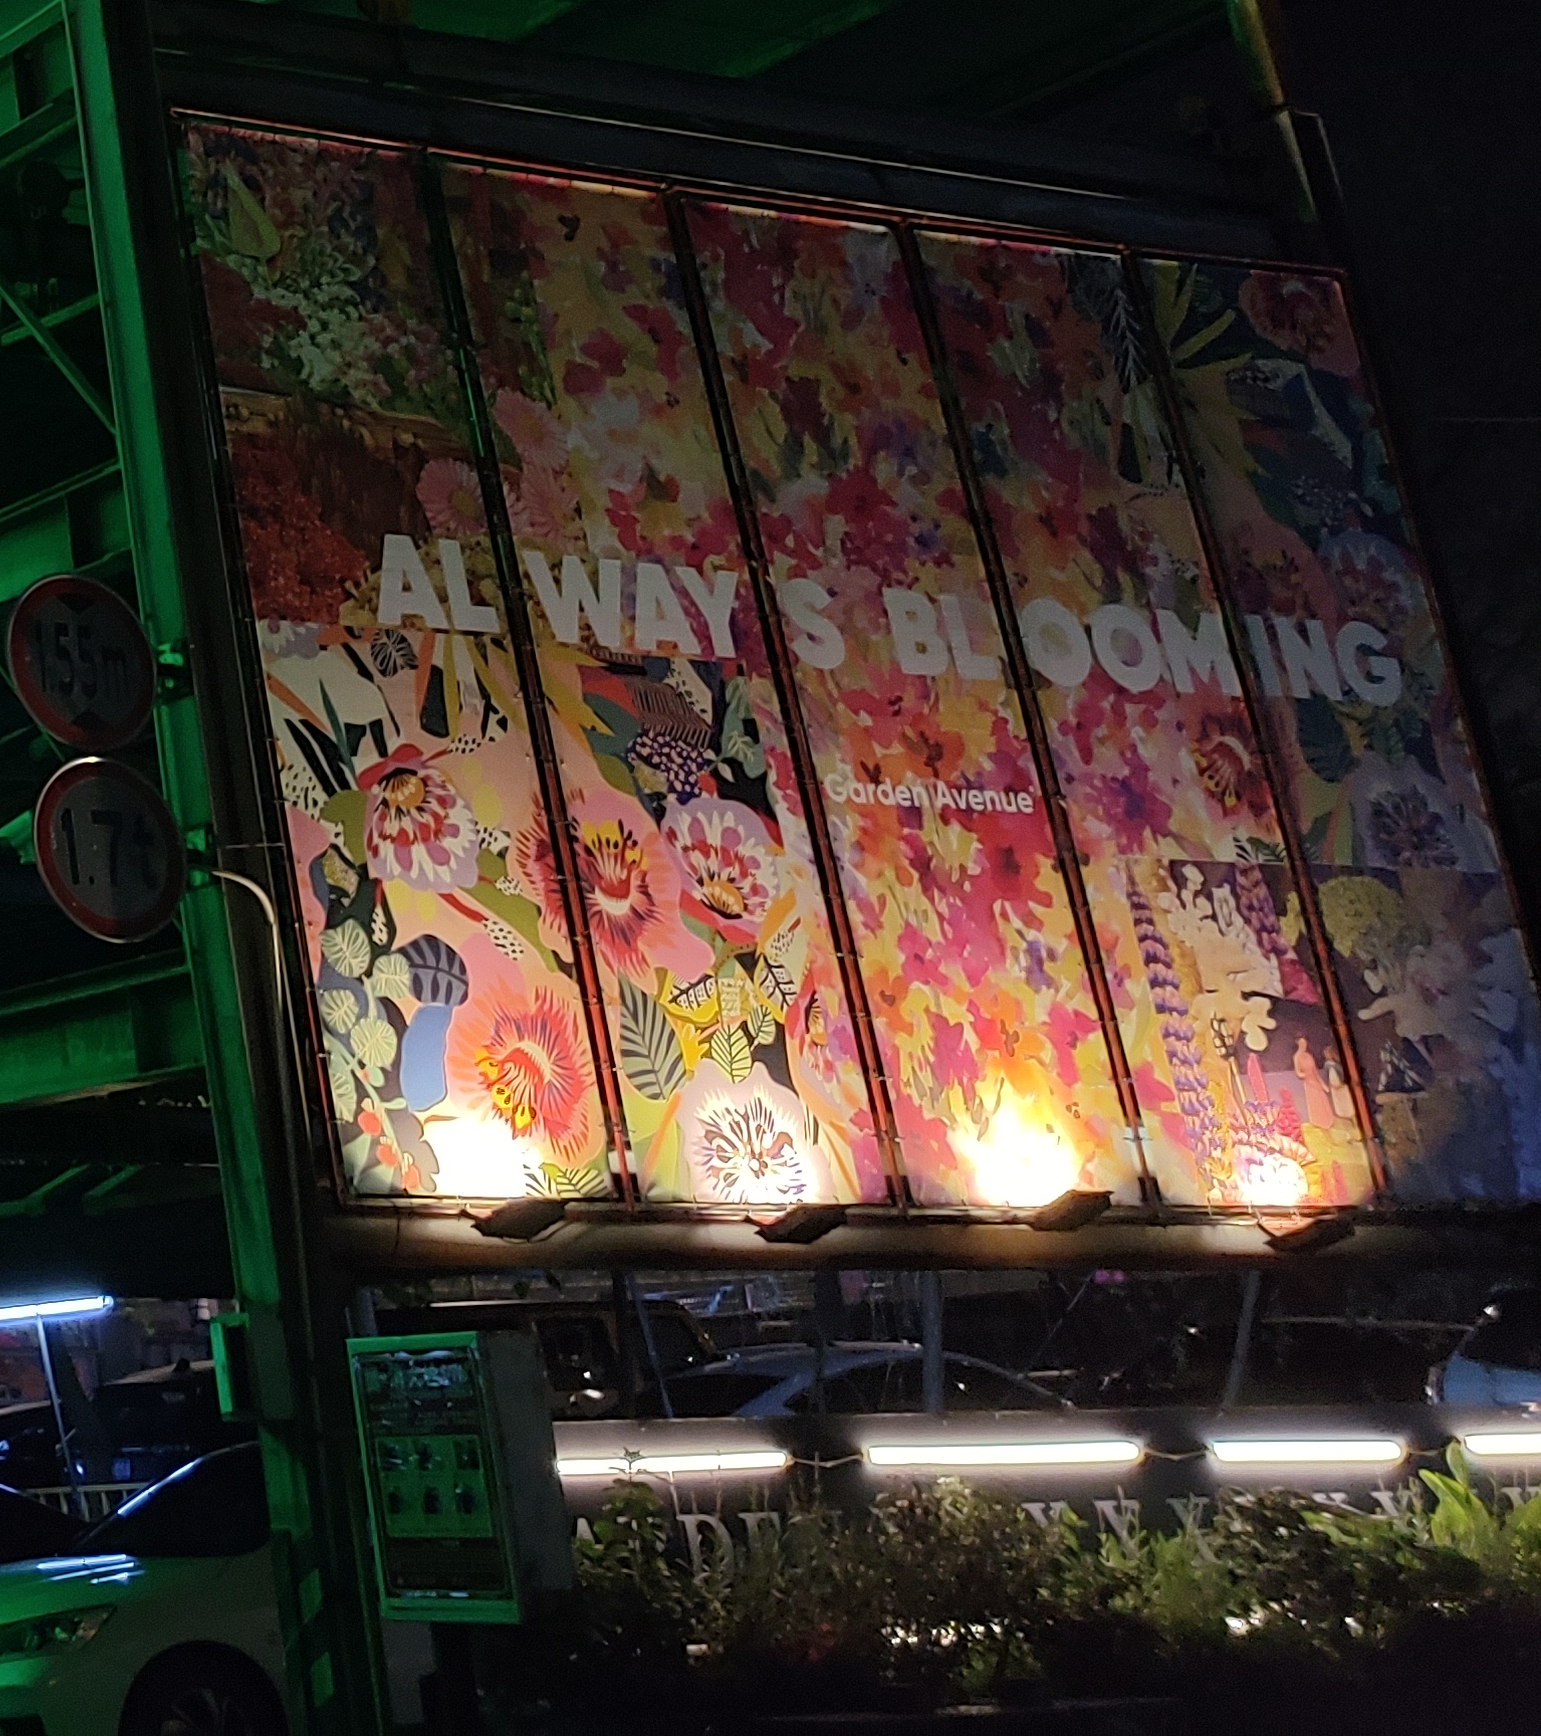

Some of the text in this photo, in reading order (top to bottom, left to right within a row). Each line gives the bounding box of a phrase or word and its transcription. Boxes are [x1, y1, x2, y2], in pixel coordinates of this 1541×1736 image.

[378, 532, 1403, 707] ALWAYS BLOOMING
[823, 773, 1034, 814] Garden Avenue
[60, 808, 158, 890] 1.7t
